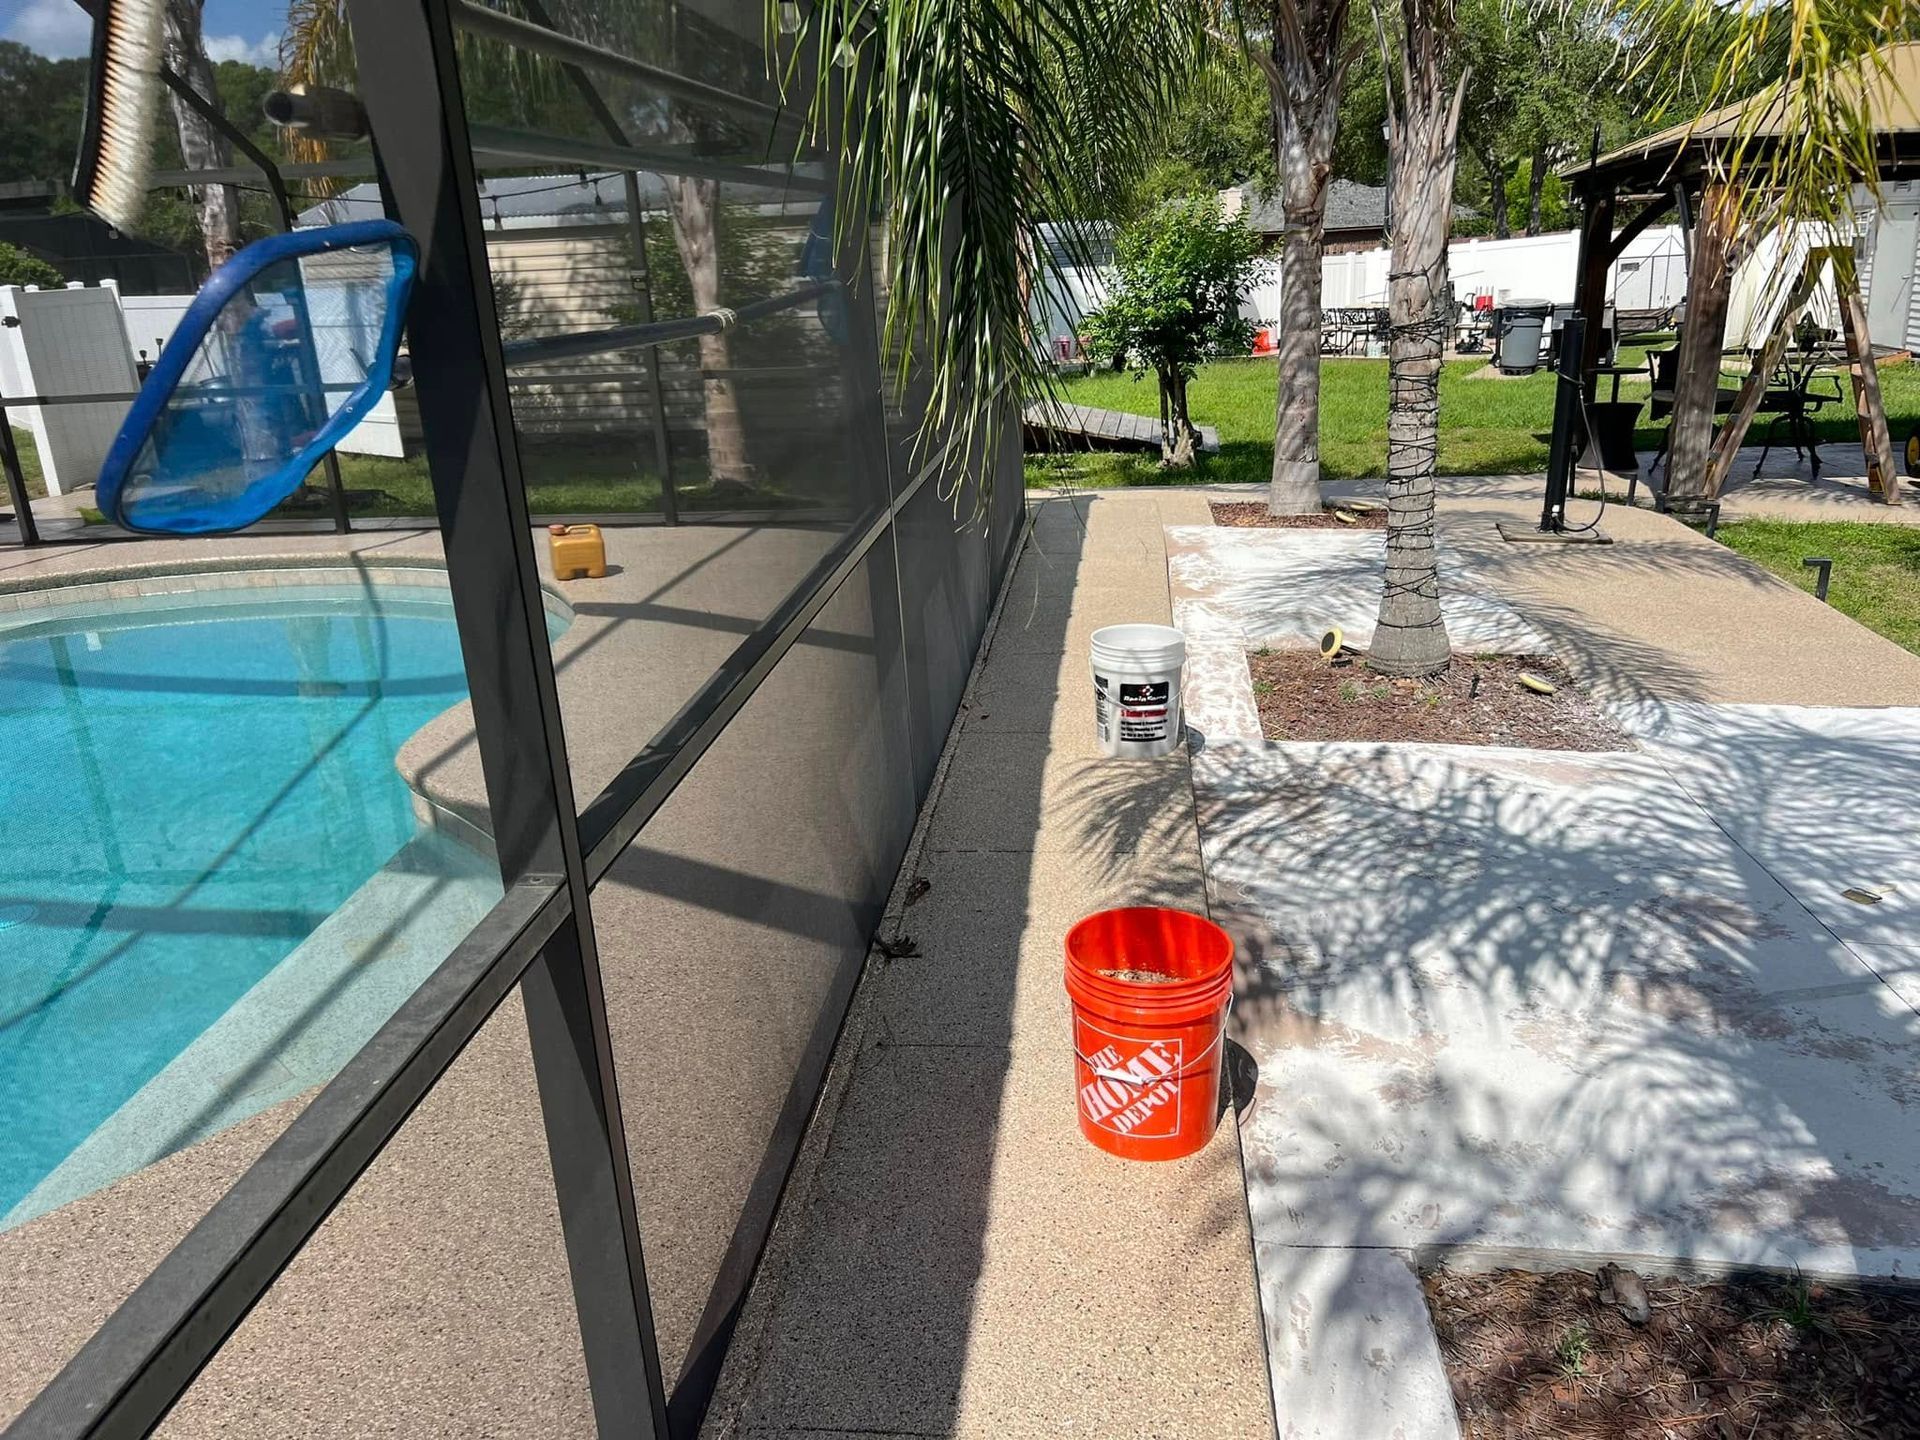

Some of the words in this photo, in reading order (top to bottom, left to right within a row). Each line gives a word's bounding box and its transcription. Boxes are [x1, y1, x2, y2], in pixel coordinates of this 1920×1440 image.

[1080, 1041, 1181, 1122] HOME
[1087, 1044, 1124, 1071] THE
[1111, 1077, 1179, 1133] DEPOT
